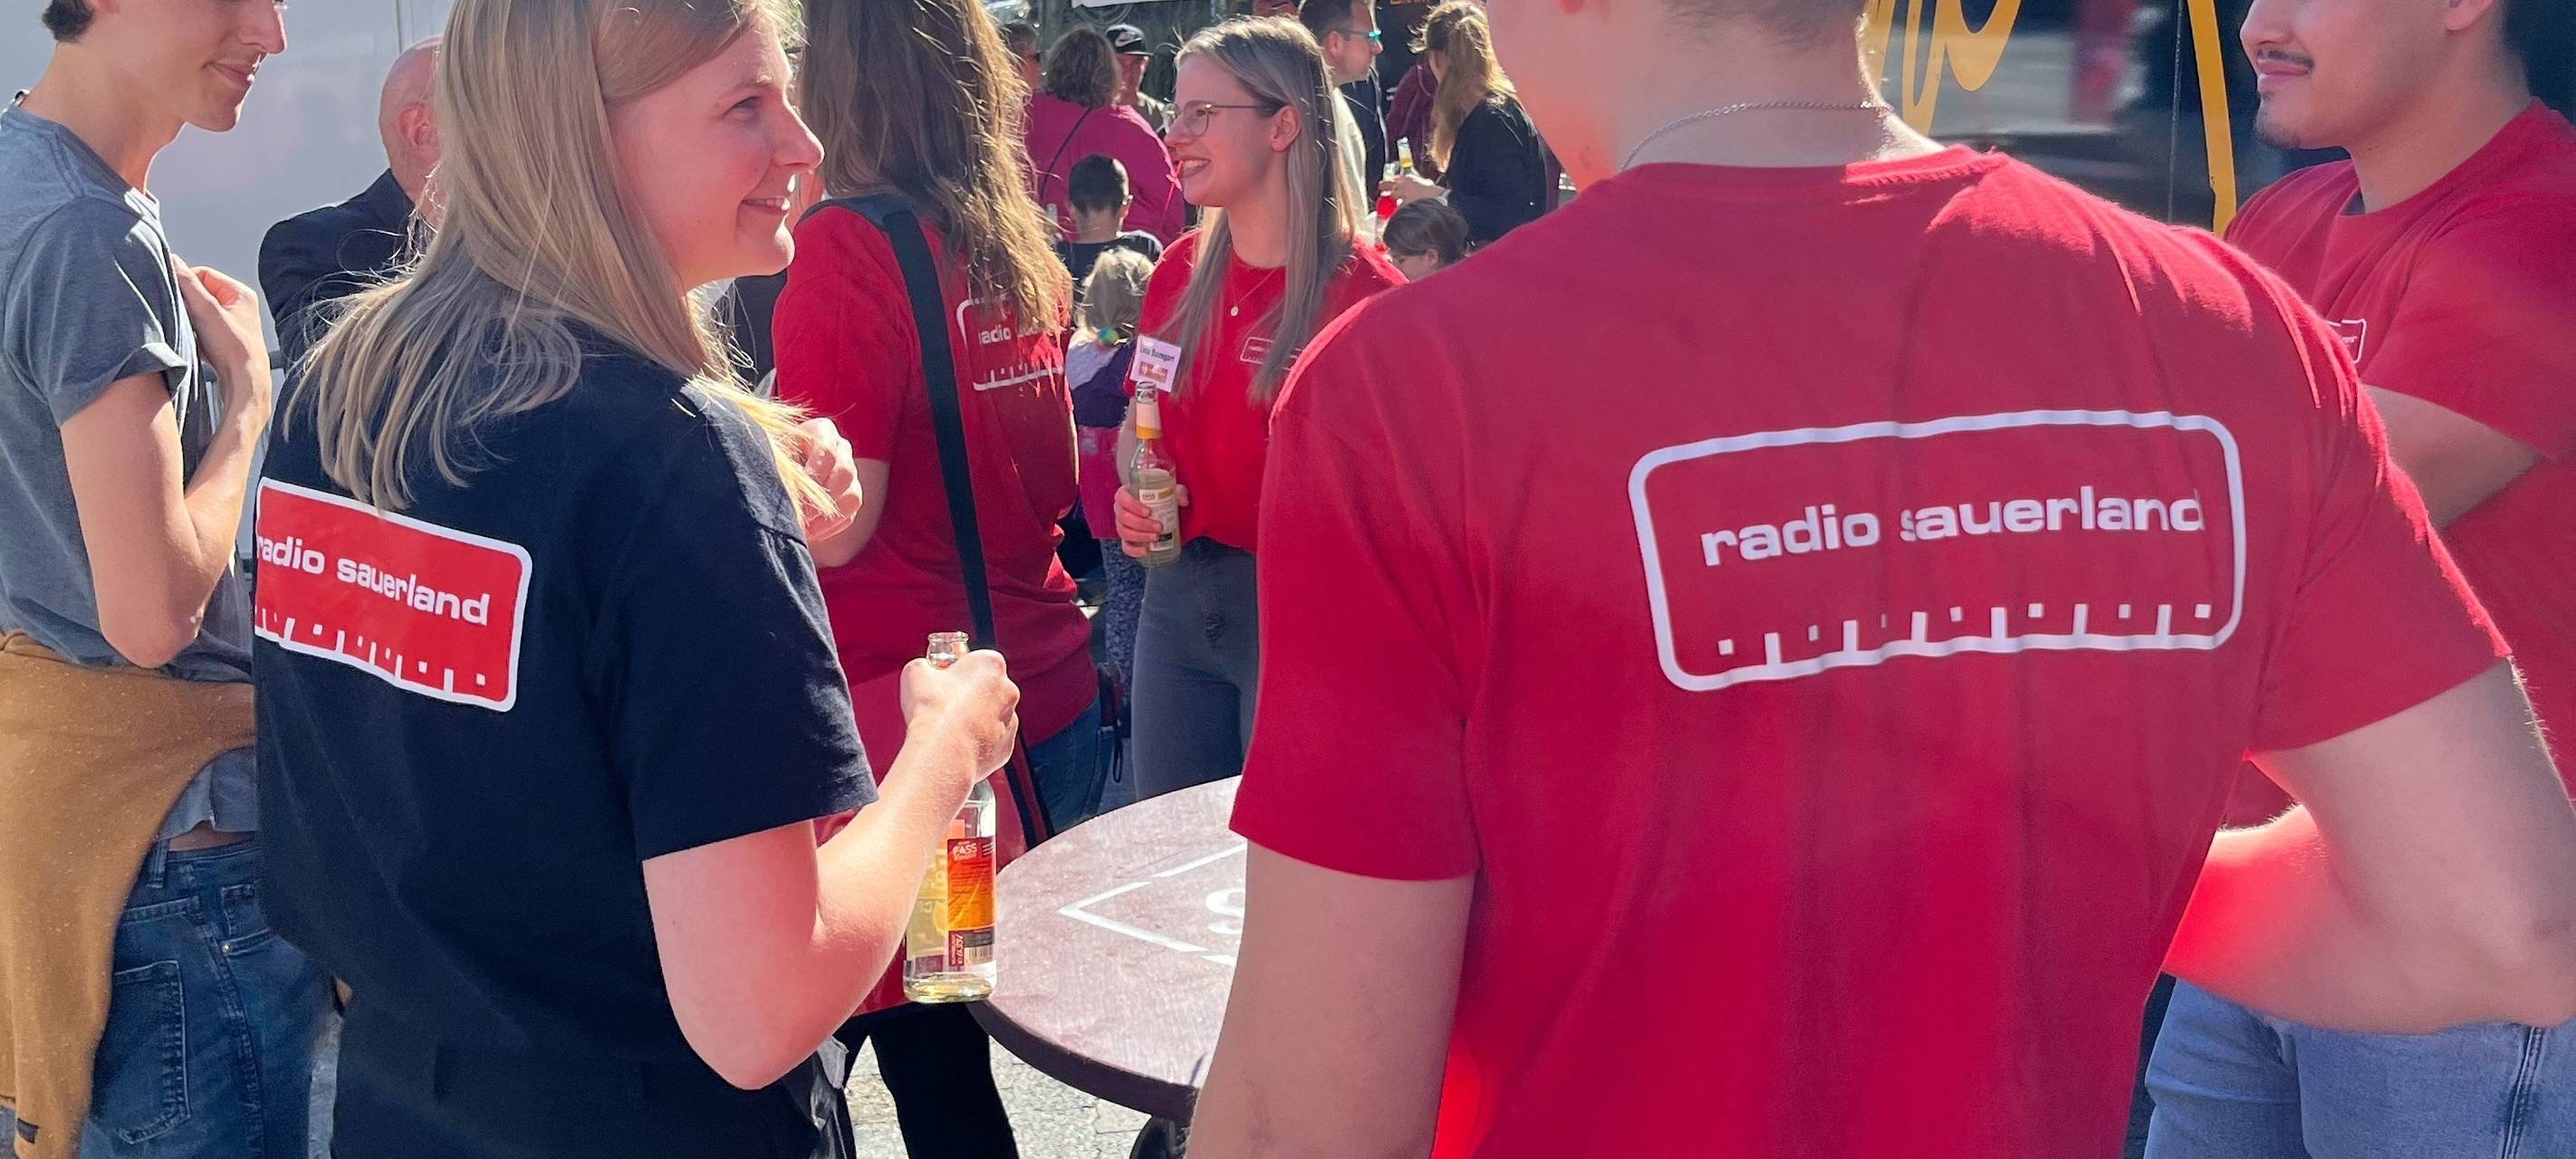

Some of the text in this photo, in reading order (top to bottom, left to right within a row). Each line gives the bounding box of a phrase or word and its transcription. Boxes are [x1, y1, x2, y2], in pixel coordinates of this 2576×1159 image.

[1700, 485, 2205, 567] radio sauerland
[337, 559, 491, 626] sauerland
